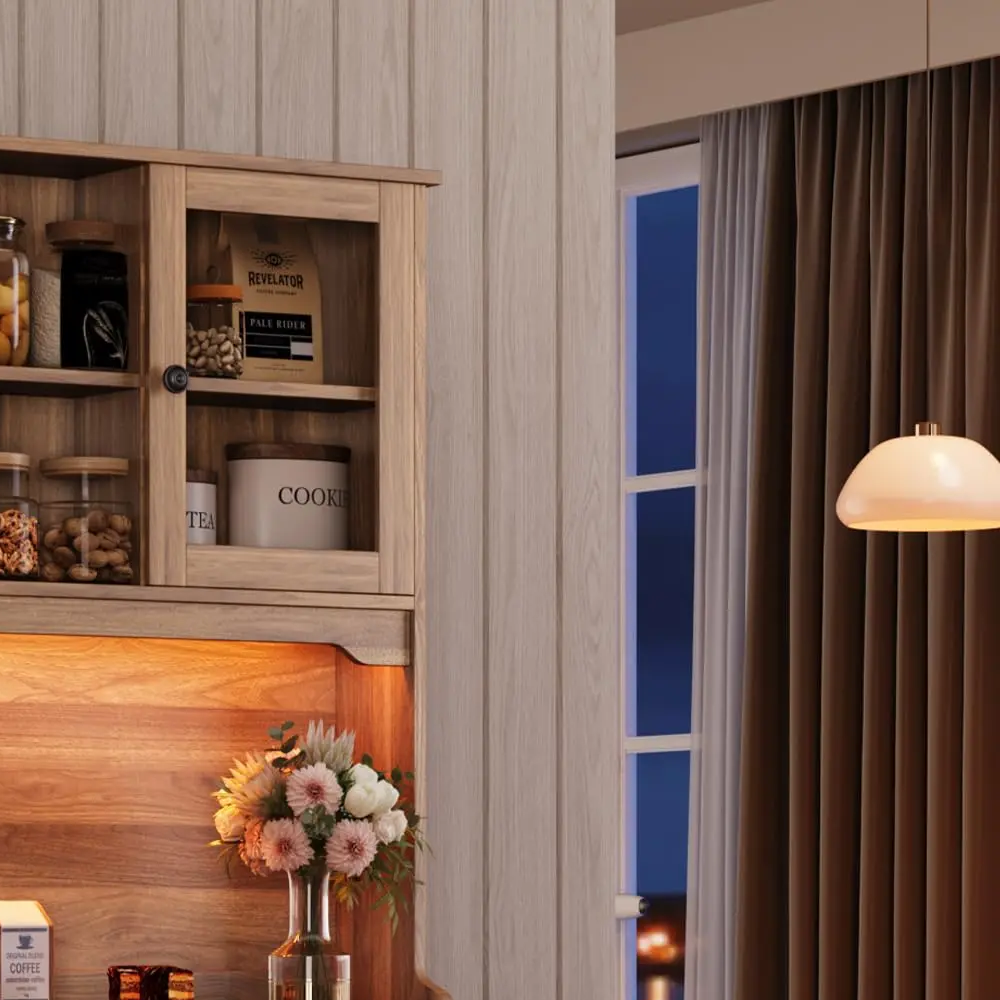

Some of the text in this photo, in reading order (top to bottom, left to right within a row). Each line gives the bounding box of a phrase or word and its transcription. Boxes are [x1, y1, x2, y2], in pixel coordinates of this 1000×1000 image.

[248, 271, 304, 290] REVELATOR
[250, 318, 306, 330] PALE RIDER
[186, 511, 215, 530] TEA
[9, 962, 41, 974] COFFEE
